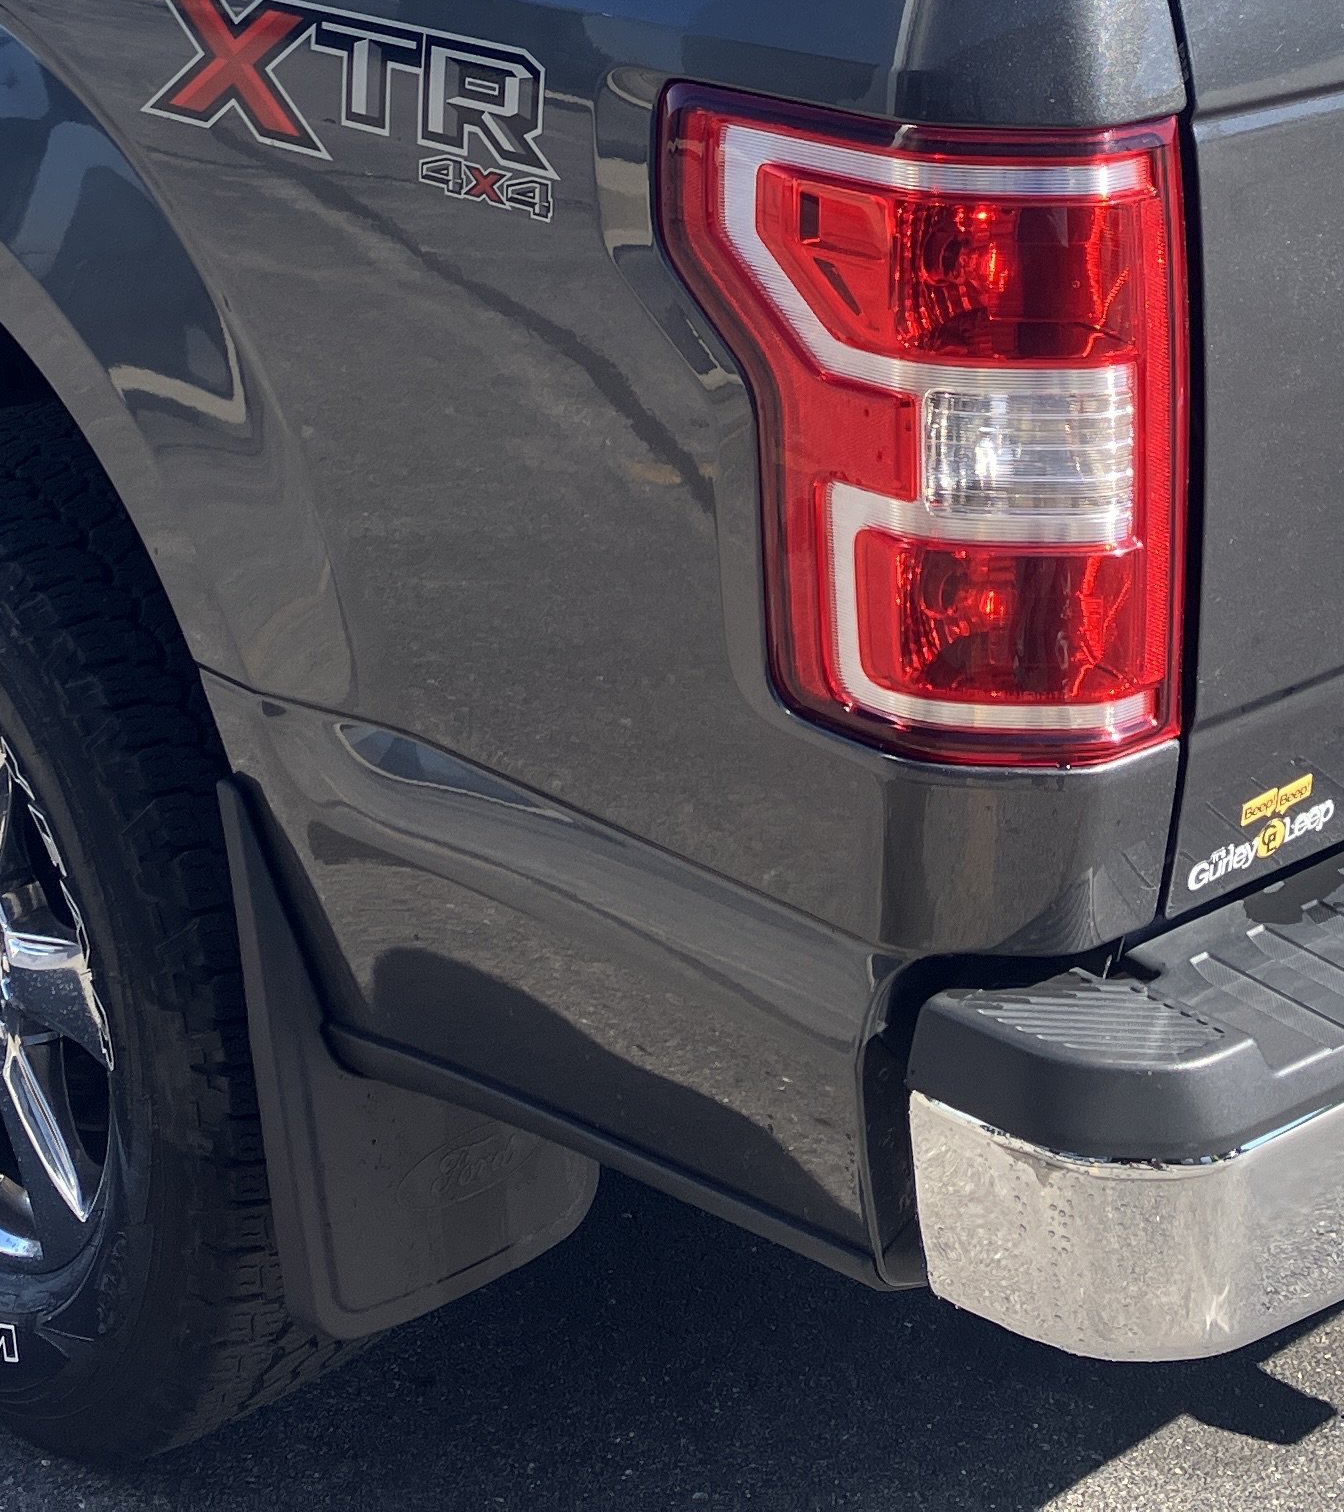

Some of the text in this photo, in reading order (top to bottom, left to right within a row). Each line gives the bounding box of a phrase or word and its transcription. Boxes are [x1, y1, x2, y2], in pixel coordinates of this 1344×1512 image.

[1244, 782, 1311, 820] Beep! Beep!
[1187, 836, 1261, 892] Gurley
[1284, 799, 1335, 844] Leep
